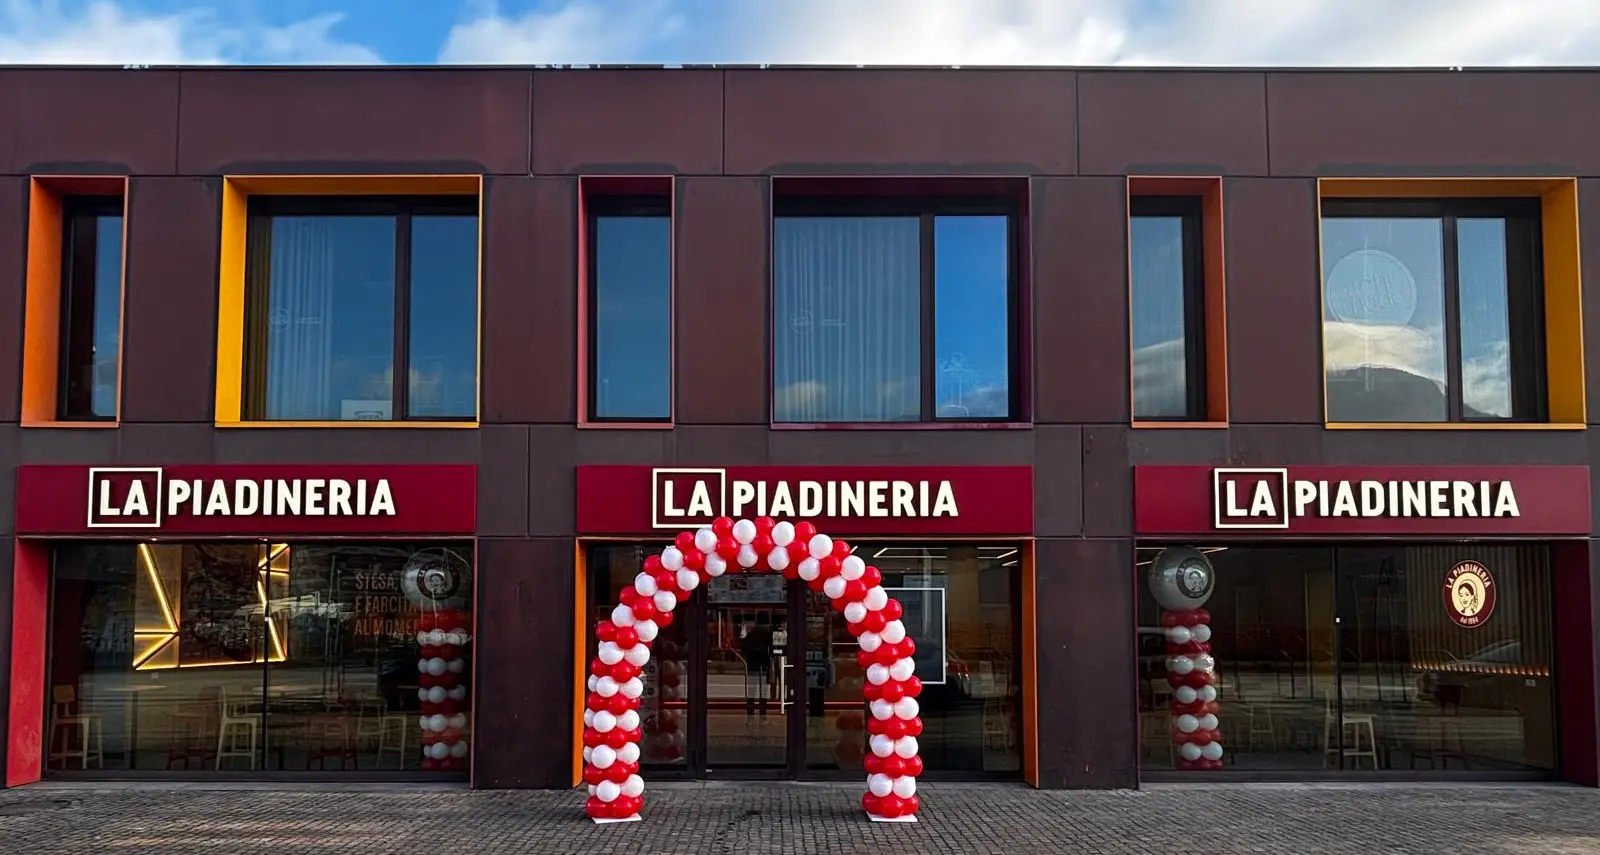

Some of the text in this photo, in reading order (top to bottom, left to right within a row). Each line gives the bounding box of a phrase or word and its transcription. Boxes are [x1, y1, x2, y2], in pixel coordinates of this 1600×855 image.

[99, 479, 396, 516] LA PIADINERIA
[664, 480, 959, 517] LA PIADINERIA
[1226, 480, 1521, 517] LA PIADINERIA
[1446, 564, 1492, 589] LA PIADINERIA
